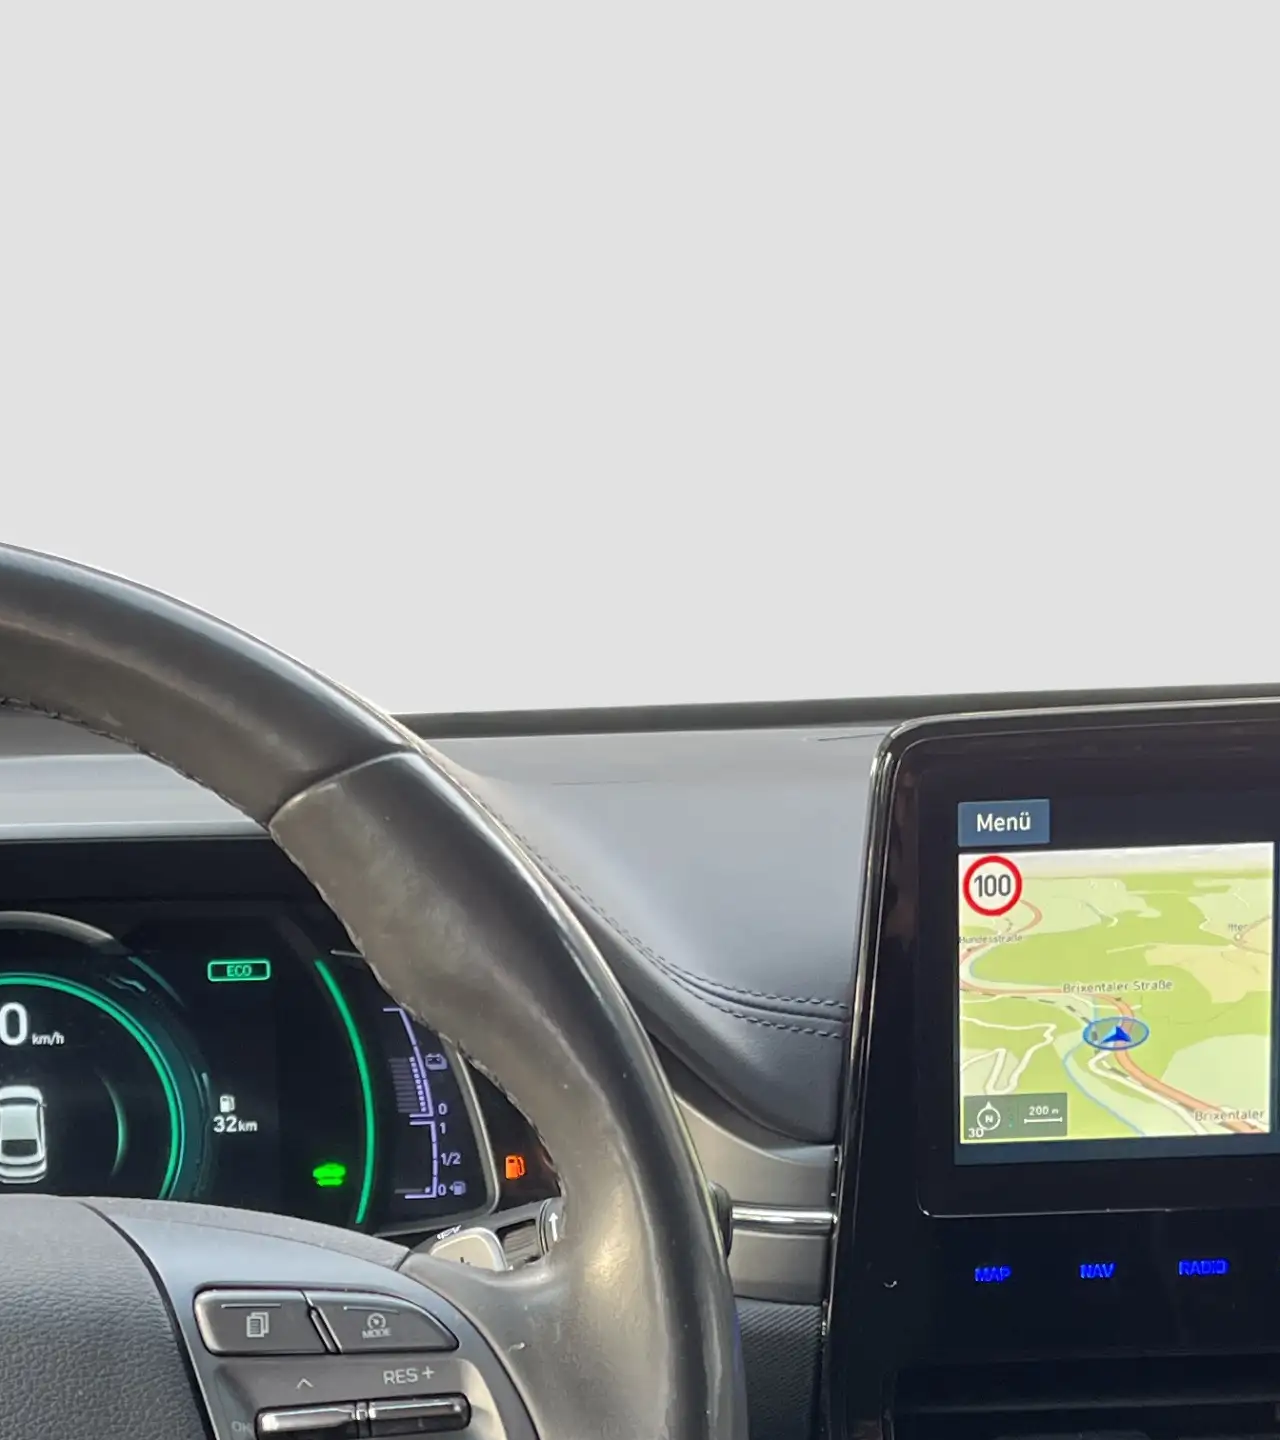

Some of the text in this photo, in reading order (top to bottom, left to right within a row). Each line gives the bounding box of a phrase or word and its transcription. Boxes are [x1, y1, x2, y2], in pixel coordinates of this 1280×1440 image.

[976, 812, 1032, 833] Menü
[973, 874, 1012, 898] 100
[225, 963, 252, 979] ECO
[1063, 979, 1173, 994] Brixentaler Straße
[31, 1031, 65, 1047] km/h
[438, 1103, 448, 1115] 0
[1029, 1106, 1049, 1116] 200
[1194, 1109, 1265, 1122] Brixentaler
[439, 1123, 446, 1134] 1
[968, 1127, 984, 1138] 30
[440, 1151, 462, 1166] 1/2
[438, 1184, 447, 1196] 0
[975, 1265, 1012, 1283] MAP
[1080, 1262, 1115, 1280] NAV
[1178, 1258, 1229, 1276] RADIO
[361, 1326, 392, 1338] MODE
[383, 1368, 418, 1384] RES
